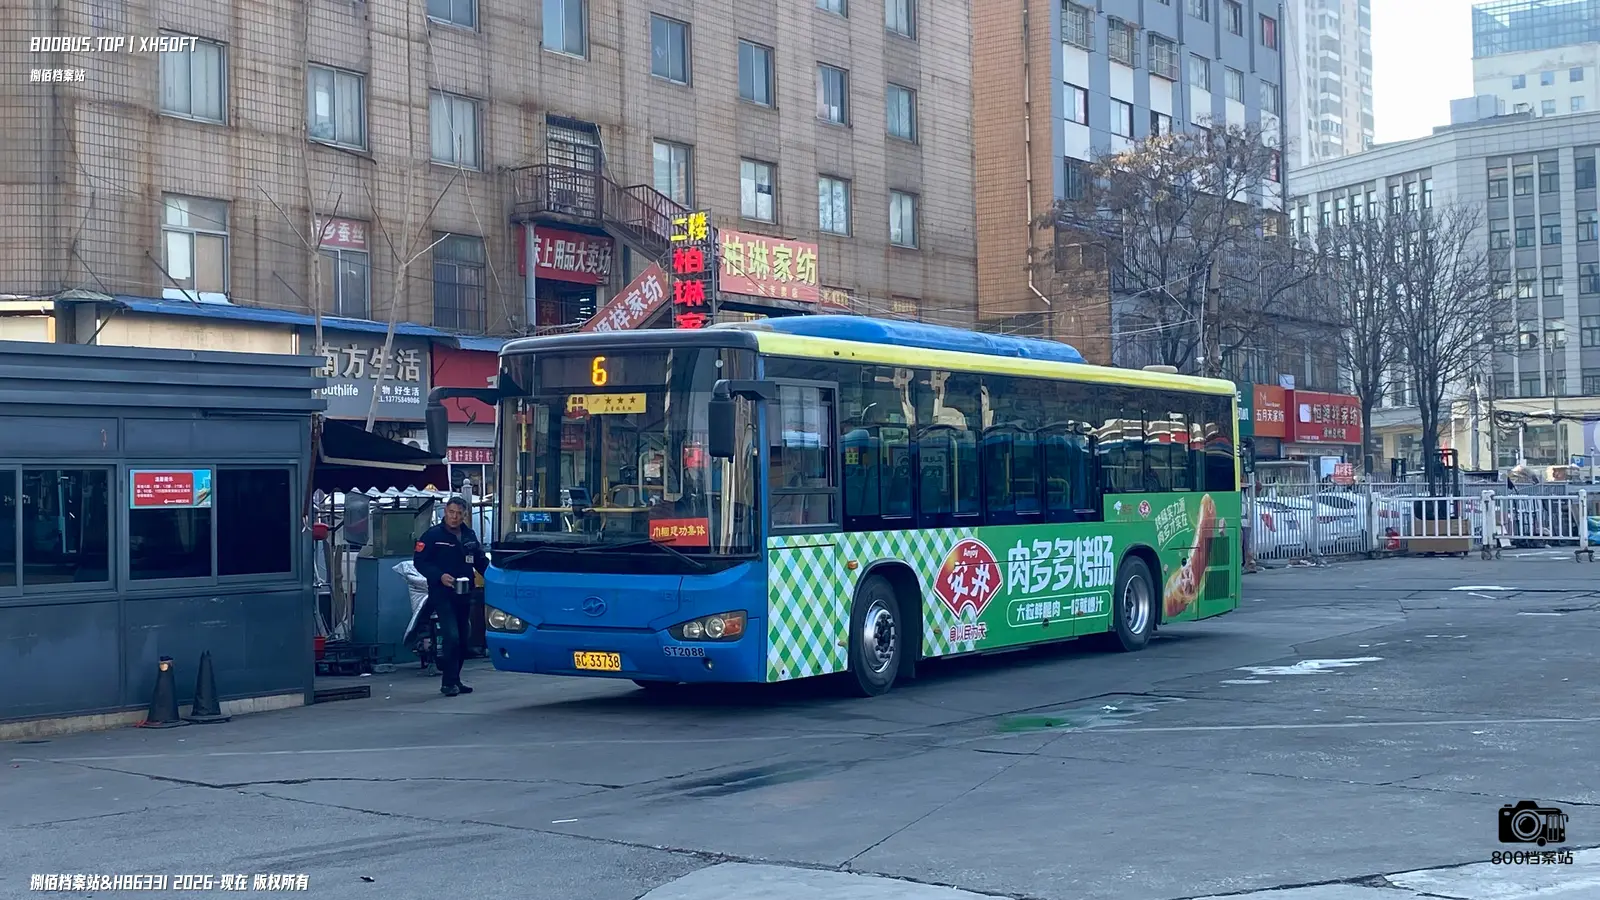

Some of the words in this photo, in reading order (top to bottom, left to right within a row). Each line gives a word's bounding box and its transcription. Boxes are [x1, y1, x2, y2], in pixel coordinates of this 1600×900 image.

[671, 212, 707, 241] 二楼
[722, 234, 819, 286] 柏琳家纺
[592, 356, 607, 386] 6
[394, 386, 420, 396] 好生活
[1256, 409, 1284, 422] 五月天家纺
[522, 513, 550, 522] 上车二元
[963, 545, 978, 558] Anjoy
[1007, 535, 1114, 595] 肉多多烤肠
[947, 560, 991, 603] 安井
[949, 622, 987, 641] 食以民为天
[664, 646, 704, 657] ST2088
[590, 654, 620, 669] 33738
